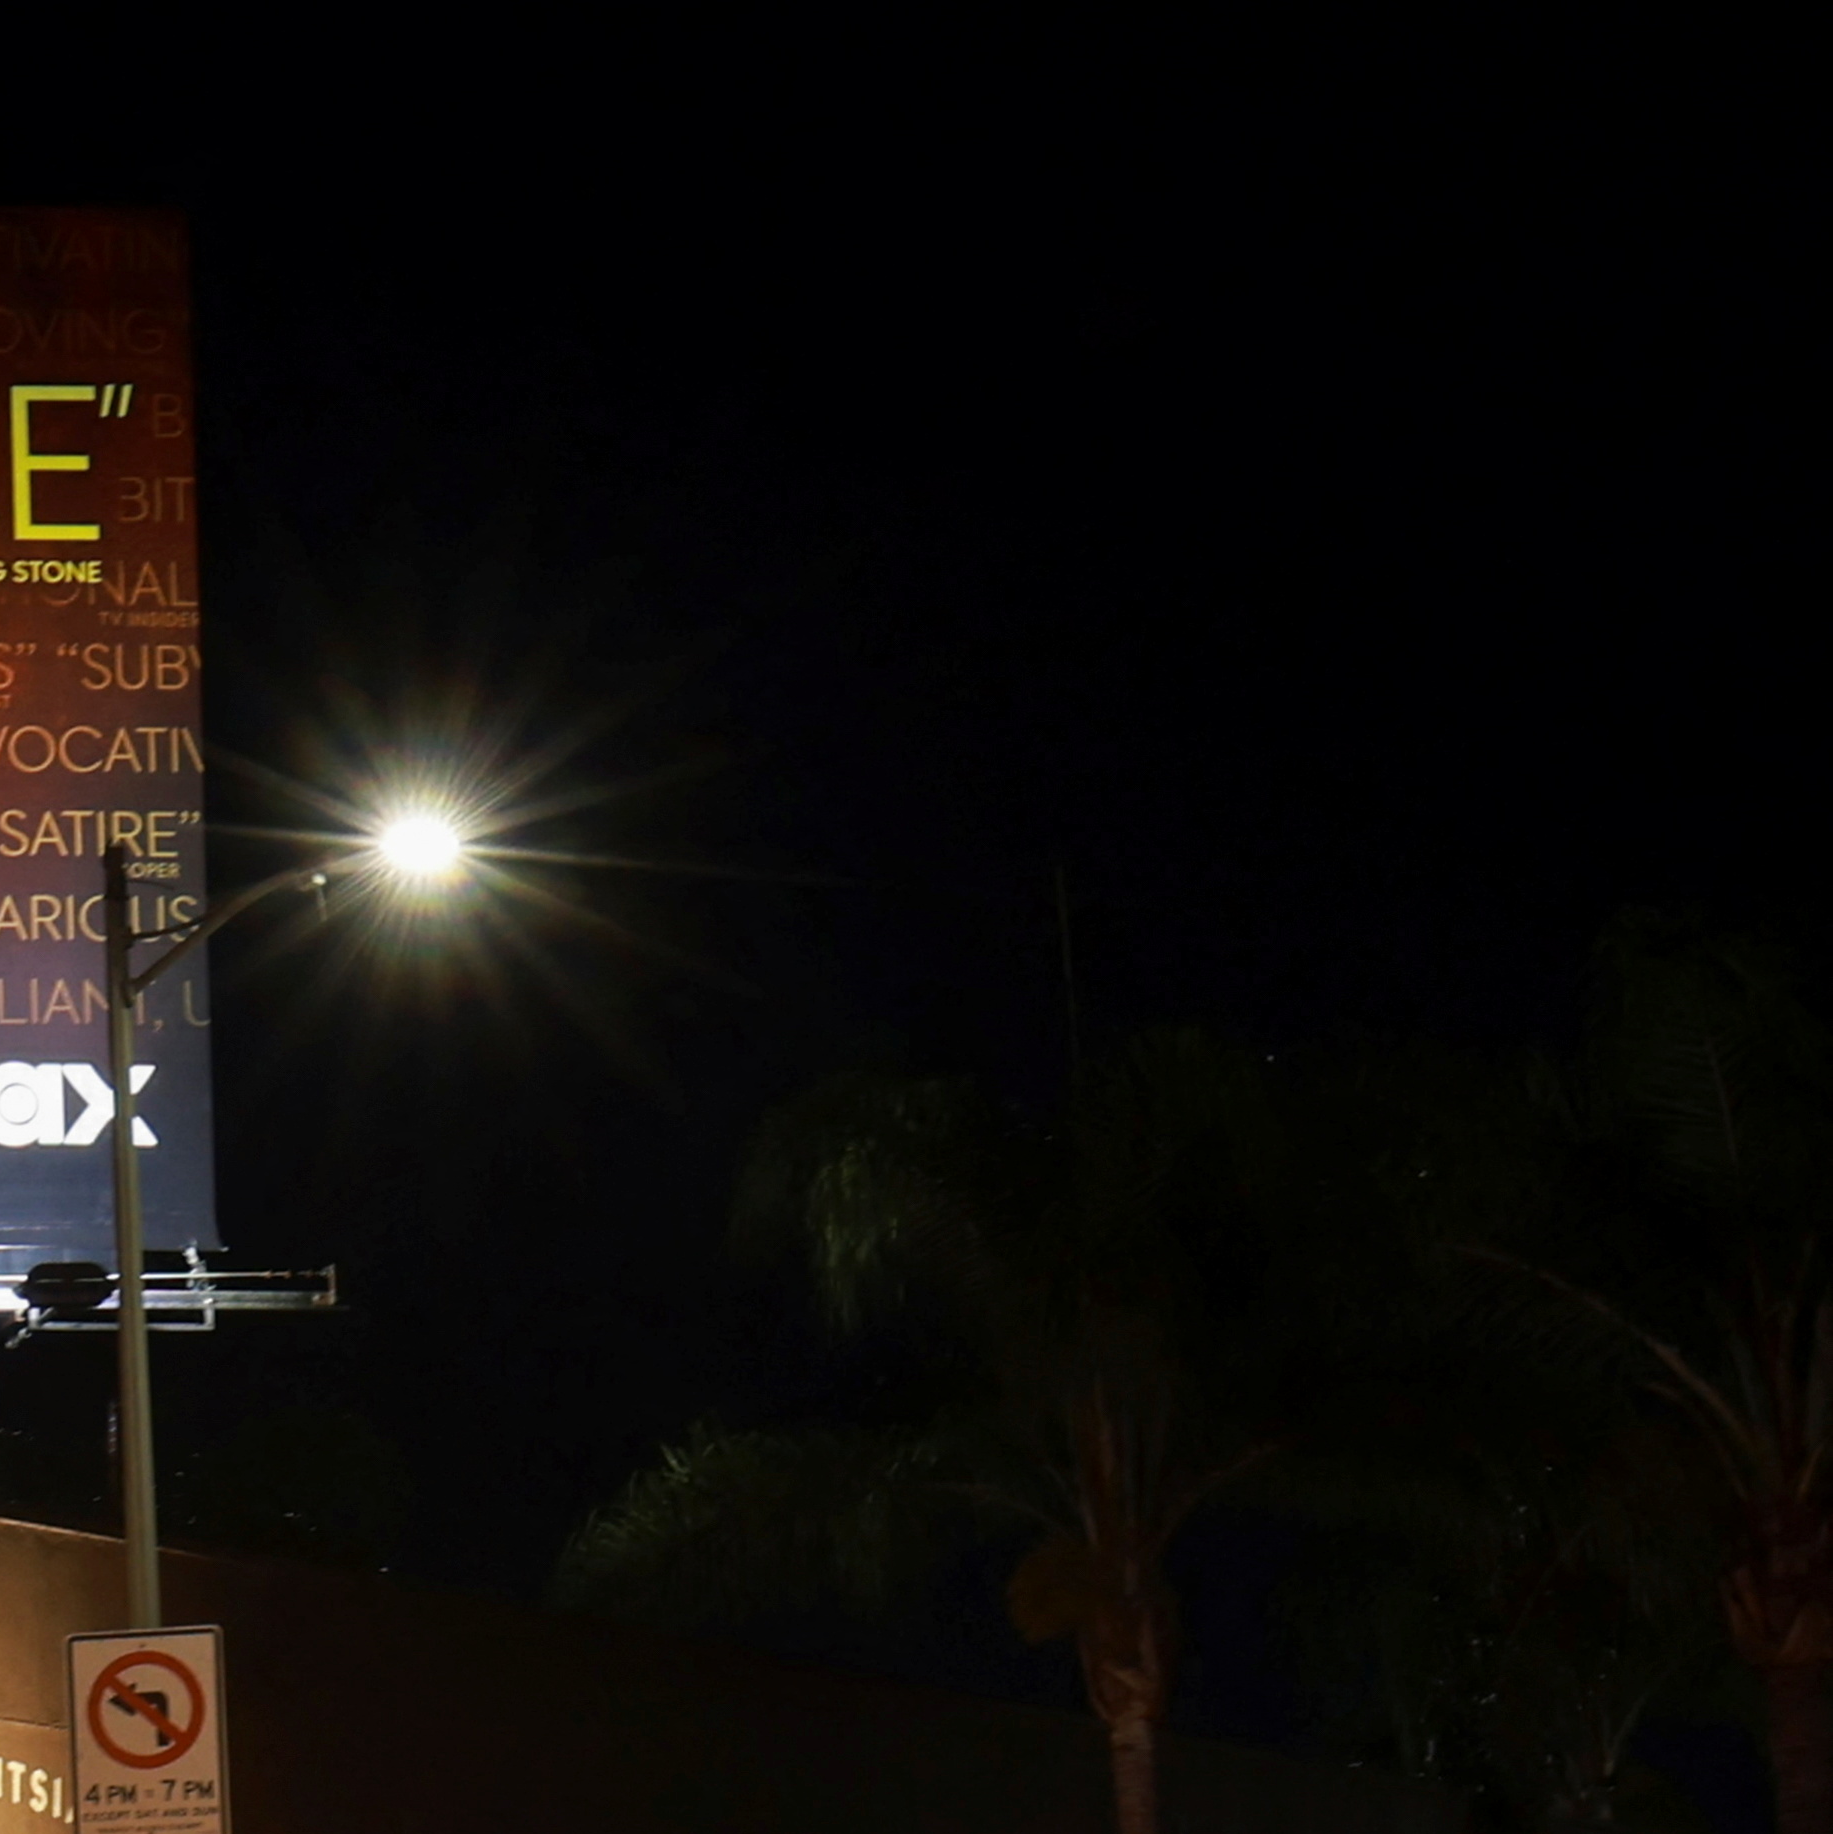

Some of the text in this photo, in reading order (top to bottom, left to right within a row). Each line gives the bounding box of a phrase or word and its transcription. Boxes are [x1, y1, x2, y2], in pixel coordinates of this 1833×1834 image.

[10, 558, 104, 586] STONE
[85, 1783, 100, 1805] 4
[106, 1784, 137, 1804] PM
[160, 1778, 177, 1801] 7
[183, 1779, 215, 1800] PM
